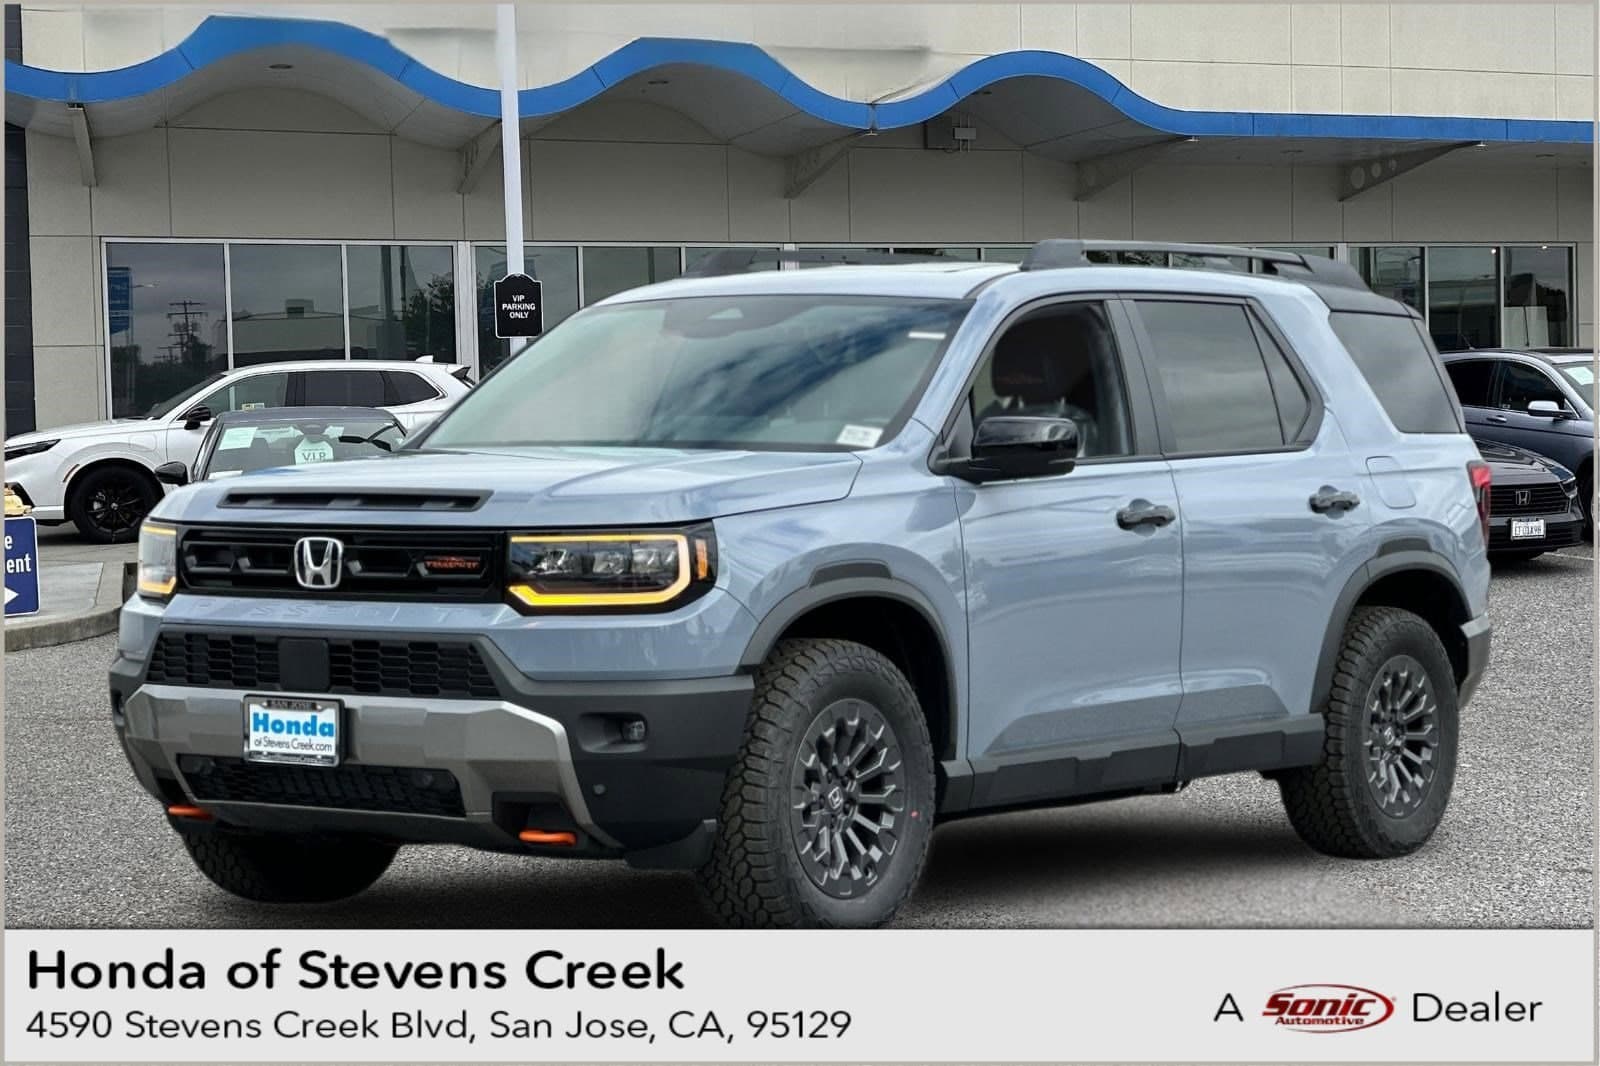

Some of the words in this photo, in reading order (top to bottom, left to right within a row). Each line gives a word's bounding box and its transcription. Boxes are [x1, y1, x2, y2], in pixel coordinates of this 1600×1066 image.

[512, 294, 525, 302] VIP
[502, 303, 536, 311] PARKING
[6, 553, 32, 574] ent
[252, 712, 335, 737] Honda
